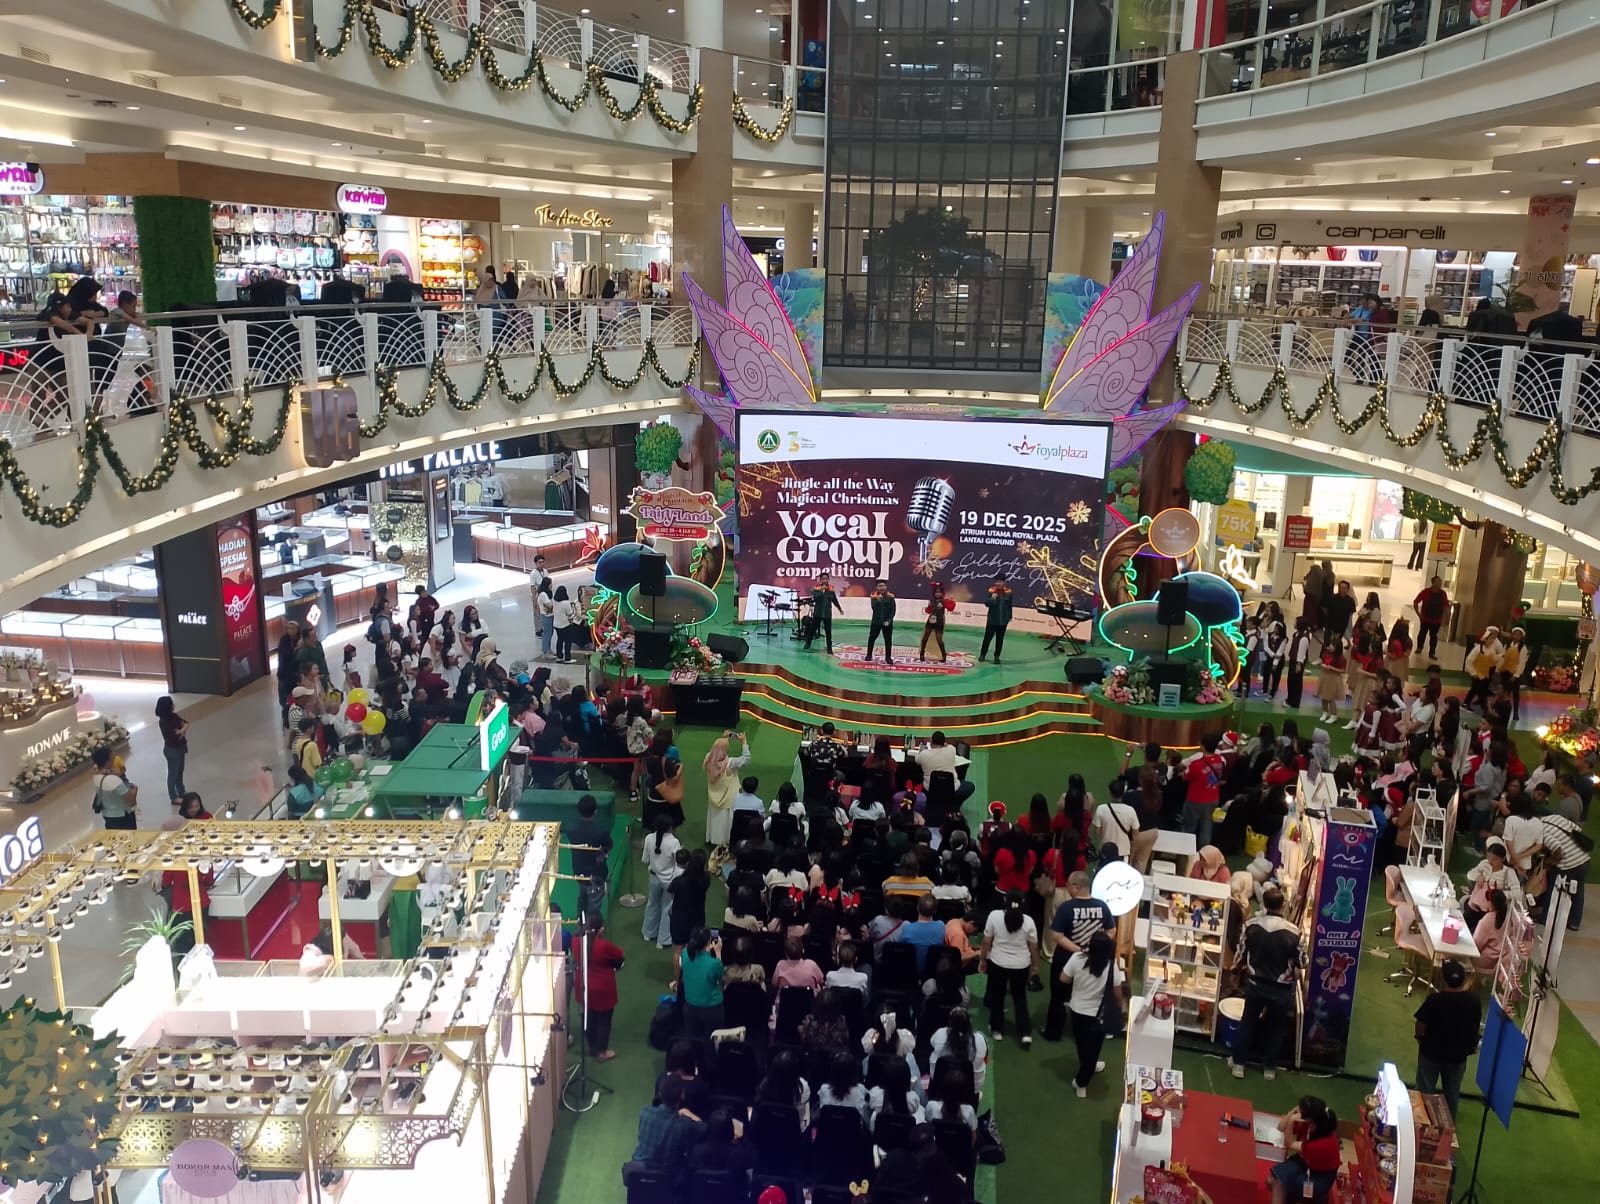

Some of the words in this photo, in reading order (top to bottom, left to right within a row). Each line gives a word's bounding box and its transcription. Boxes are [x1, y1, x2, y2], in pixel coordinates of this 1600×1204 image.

[580, 208, 614, 227] Store
[1326, 225, 1446, 241] carparelli
[422, 439, 502, 471] PALACE
[781, 477, 821, 492] Jingle
[823, 478, 840, 489] all
[843, 478, 863, 489] the
[866, 478, 895, 493] Way
[776, 491, 828, 507] Magical
[831, 492, 899, 505] Christmas
[776, 510, 889, 539] Vocal
[959, 510, 978, 526] 19
[983, 512, 1017, 528] DEC
[1022, 514, 1066, 533] 2025
[1221, 514, 1252, 533] 75K
[960, 528, 986, 536] ATRIUM
[987, 530, 1011, 538] UTAMA
[1012, 532, 1035, 540] ROYAL
[960, 536, 984, 544] LANTAI
[985, 537, 1015, 546] GROUND
[220, 551, 248, 567] SPESIAL
[776, 536, 904, 580] Group
[776, 563, 875, 579] competition
[177, 614, 208, 625] PALACE
[27, 726, 73, 758] BONAVIE
[1073, 906, 1103, 920] FAITH
[1328, 931, 1348, 939] ART
[1318, 939, 1357, 948] STUDIO
